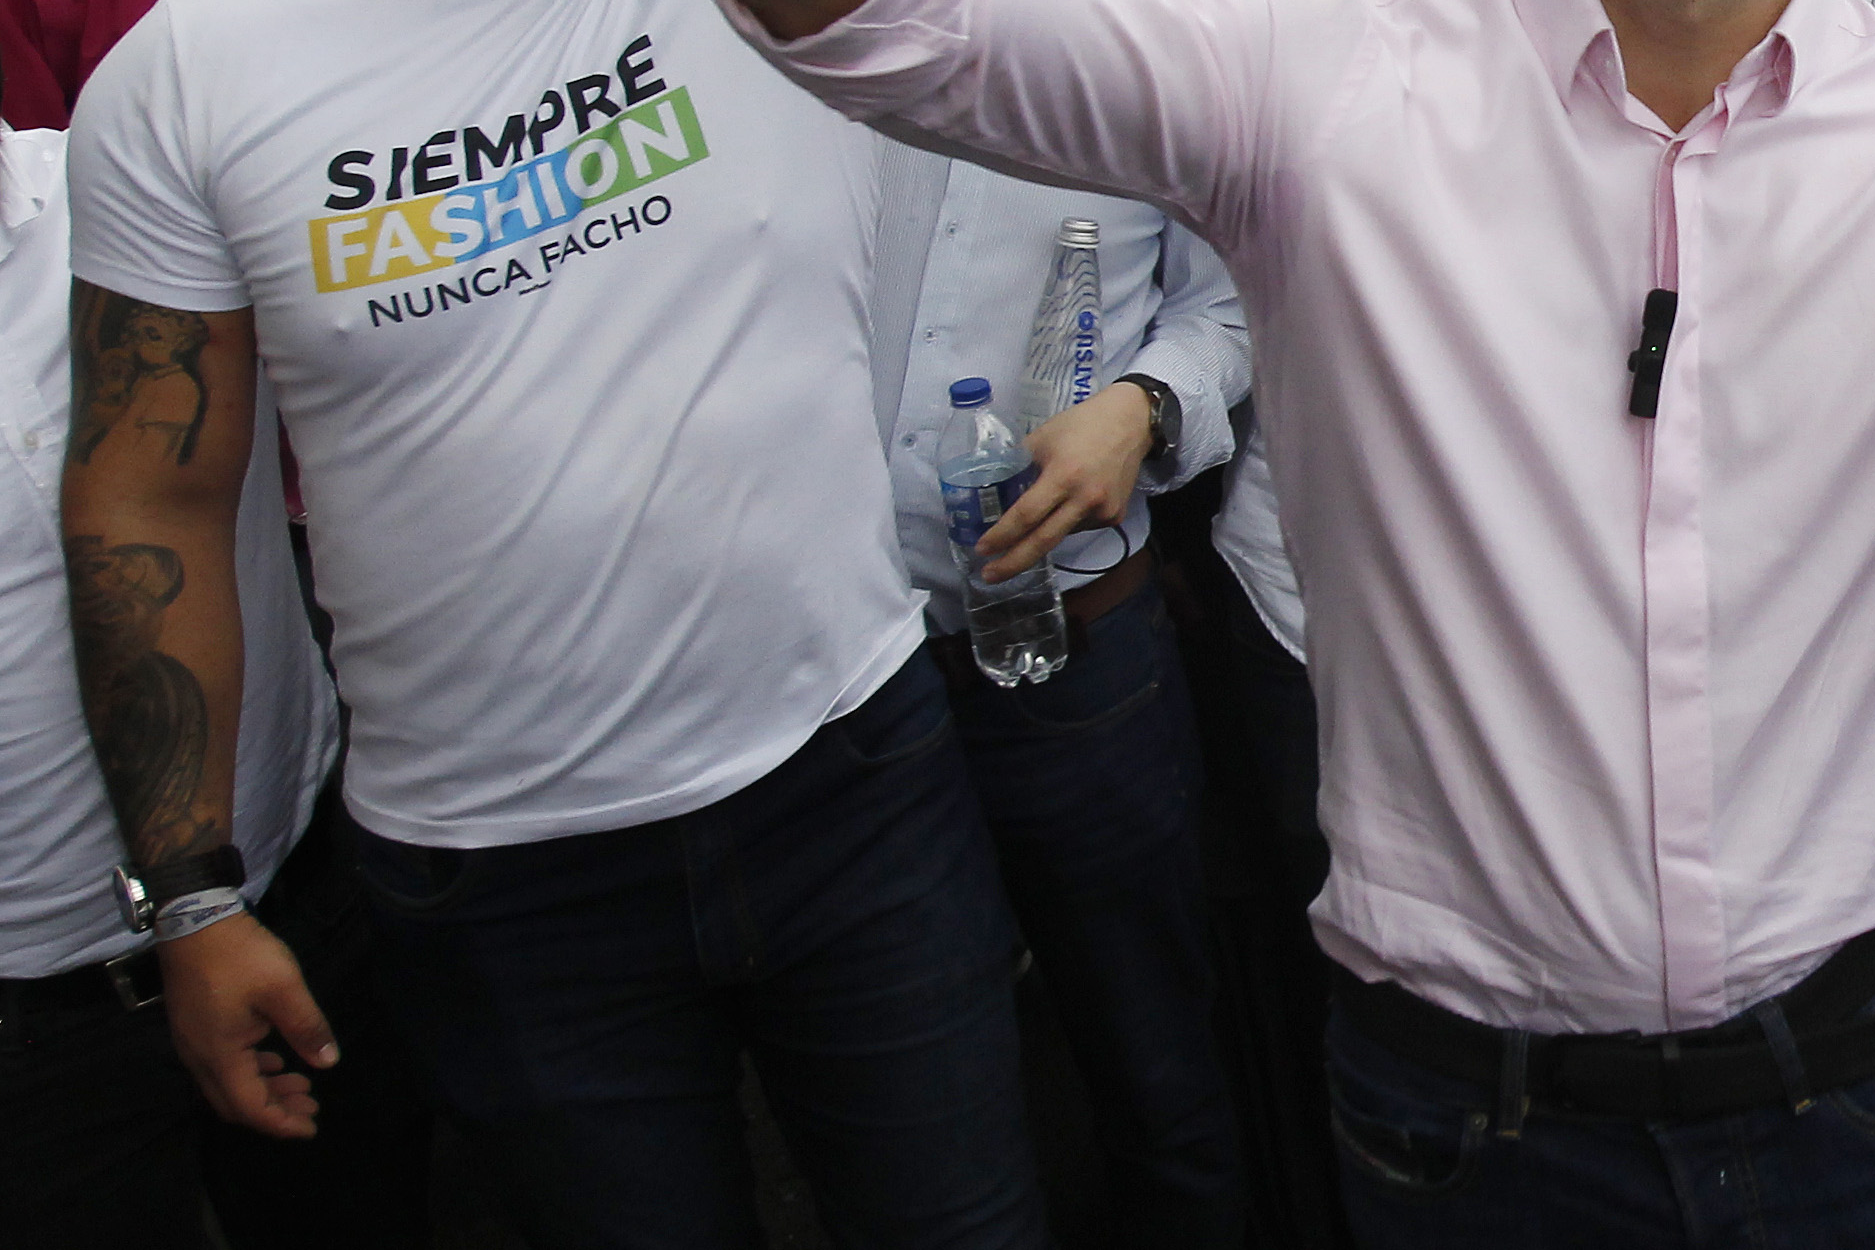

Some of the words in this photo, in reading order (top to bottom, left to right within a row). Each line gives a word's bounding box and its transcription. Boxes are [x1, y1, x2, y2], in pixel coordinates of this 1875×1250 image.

[324, 33, 667, 211] SIEMPRE
[325, 99, 692, 284] FASHION
[367, 258, 533, 328] NUNCA
[539, 194, 672, 274] FACHO
[1073, 333, 1096, 405] HATSU
